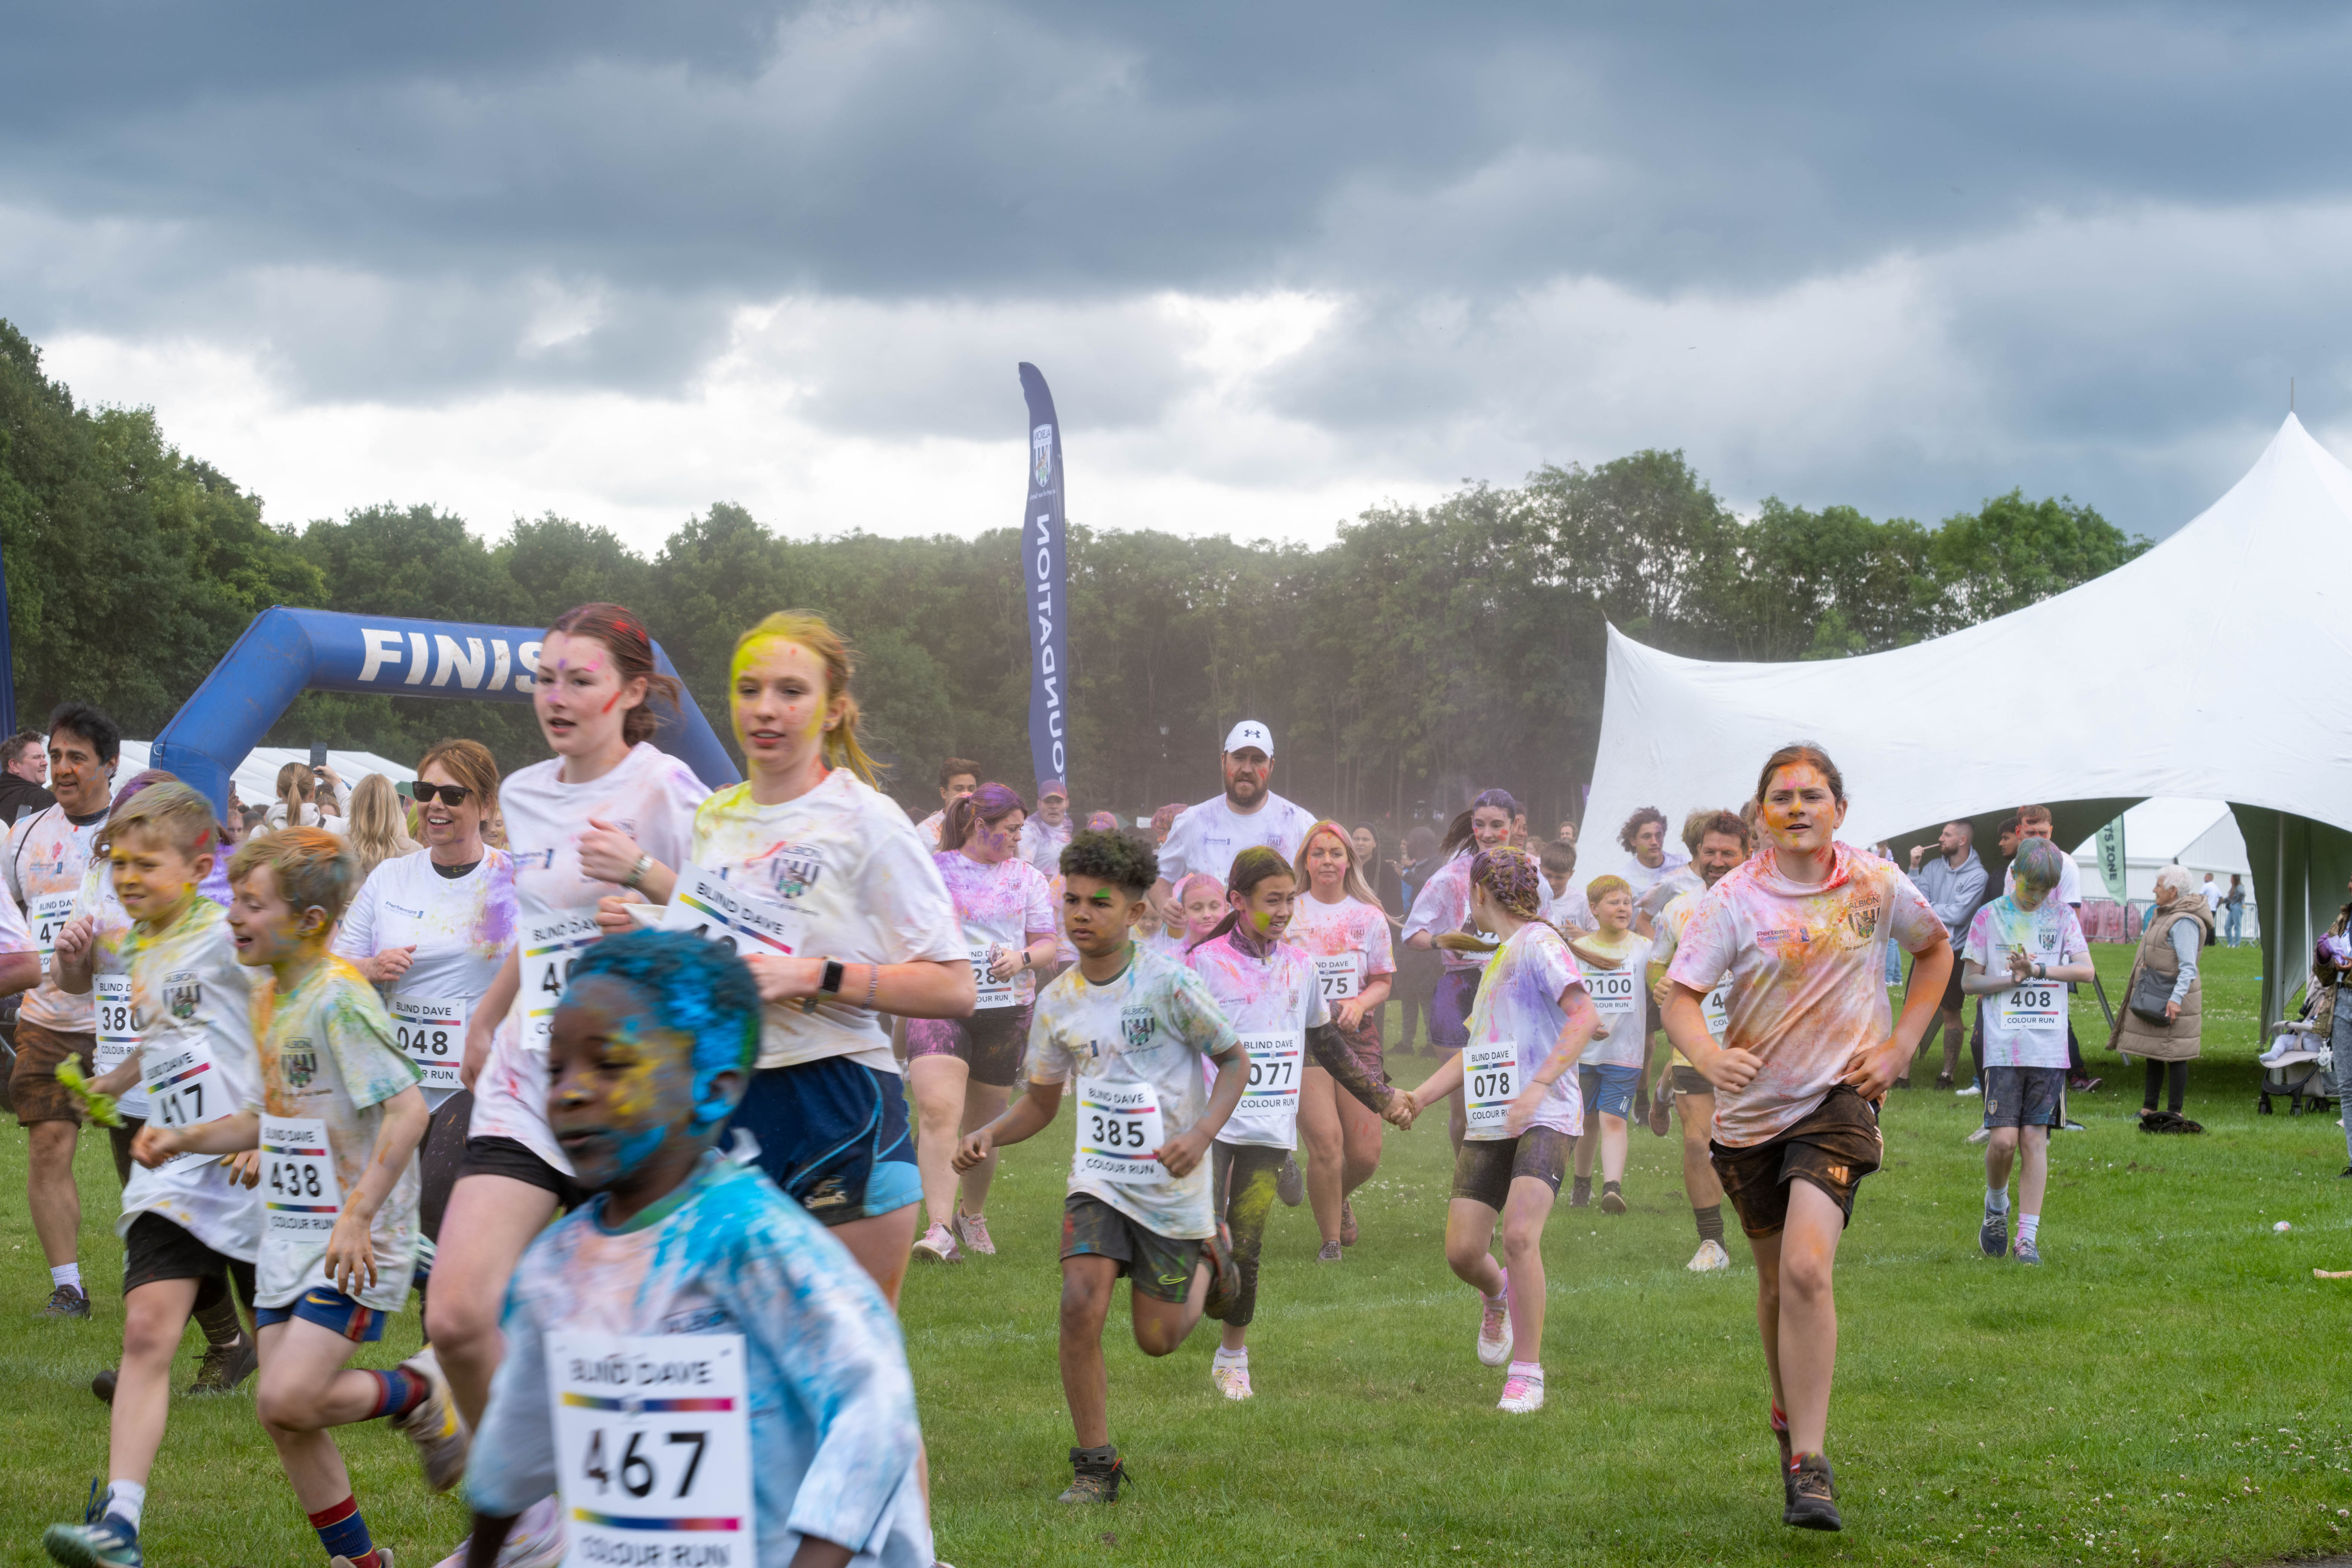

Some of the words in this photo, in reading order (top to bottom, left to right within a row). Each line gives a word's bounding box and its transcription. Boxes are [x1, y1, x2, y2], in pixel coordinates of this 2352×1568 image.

[2106, 845, 2117, 880] ZONE
[40, 901, 57, 911] BLIND
[60, 899, 75, 907] DA
[386, 901, 417, 914] Pertemps
[1848, 896, 1879, 909] ALBION
[972, 967, 1010, 985] 28
[100, 983, 123, 991] BLIND
[2011, 991, 2050, 1007] 408
[396, 1001, 419, 1013] BLIND
[423, 1006, 451, 1015] DAVE
[398, 1026, 448, 1055] 048
[102, 1046, 125, 1055] COLOUR
[1472, 1053, 1489, 1062] BLIND
[1492, 1050, 1509, 1059] DAVE
[431, 1071, 453, 1080] RUN
[1248, 1062, 1292, 1086] 077
[1475, 1073, 1509, 1098] 078
[1089, 1088, 1112, 1101] BLIND
[1114, 1093, 1145, 1104] DAVE
[1620, 1096, 1629, 1112] 10
[1473, 1110, 1499, 1119] COLOUR
[1092, 1116, 1144, 1147] 385
[1086, 1158, 1126, 1174] COLOUR
[1129, 1164, 1155, 1174] RUN
[271, 1162, 323, 1197] 438
[583, 1429, 710, 1498] 467
